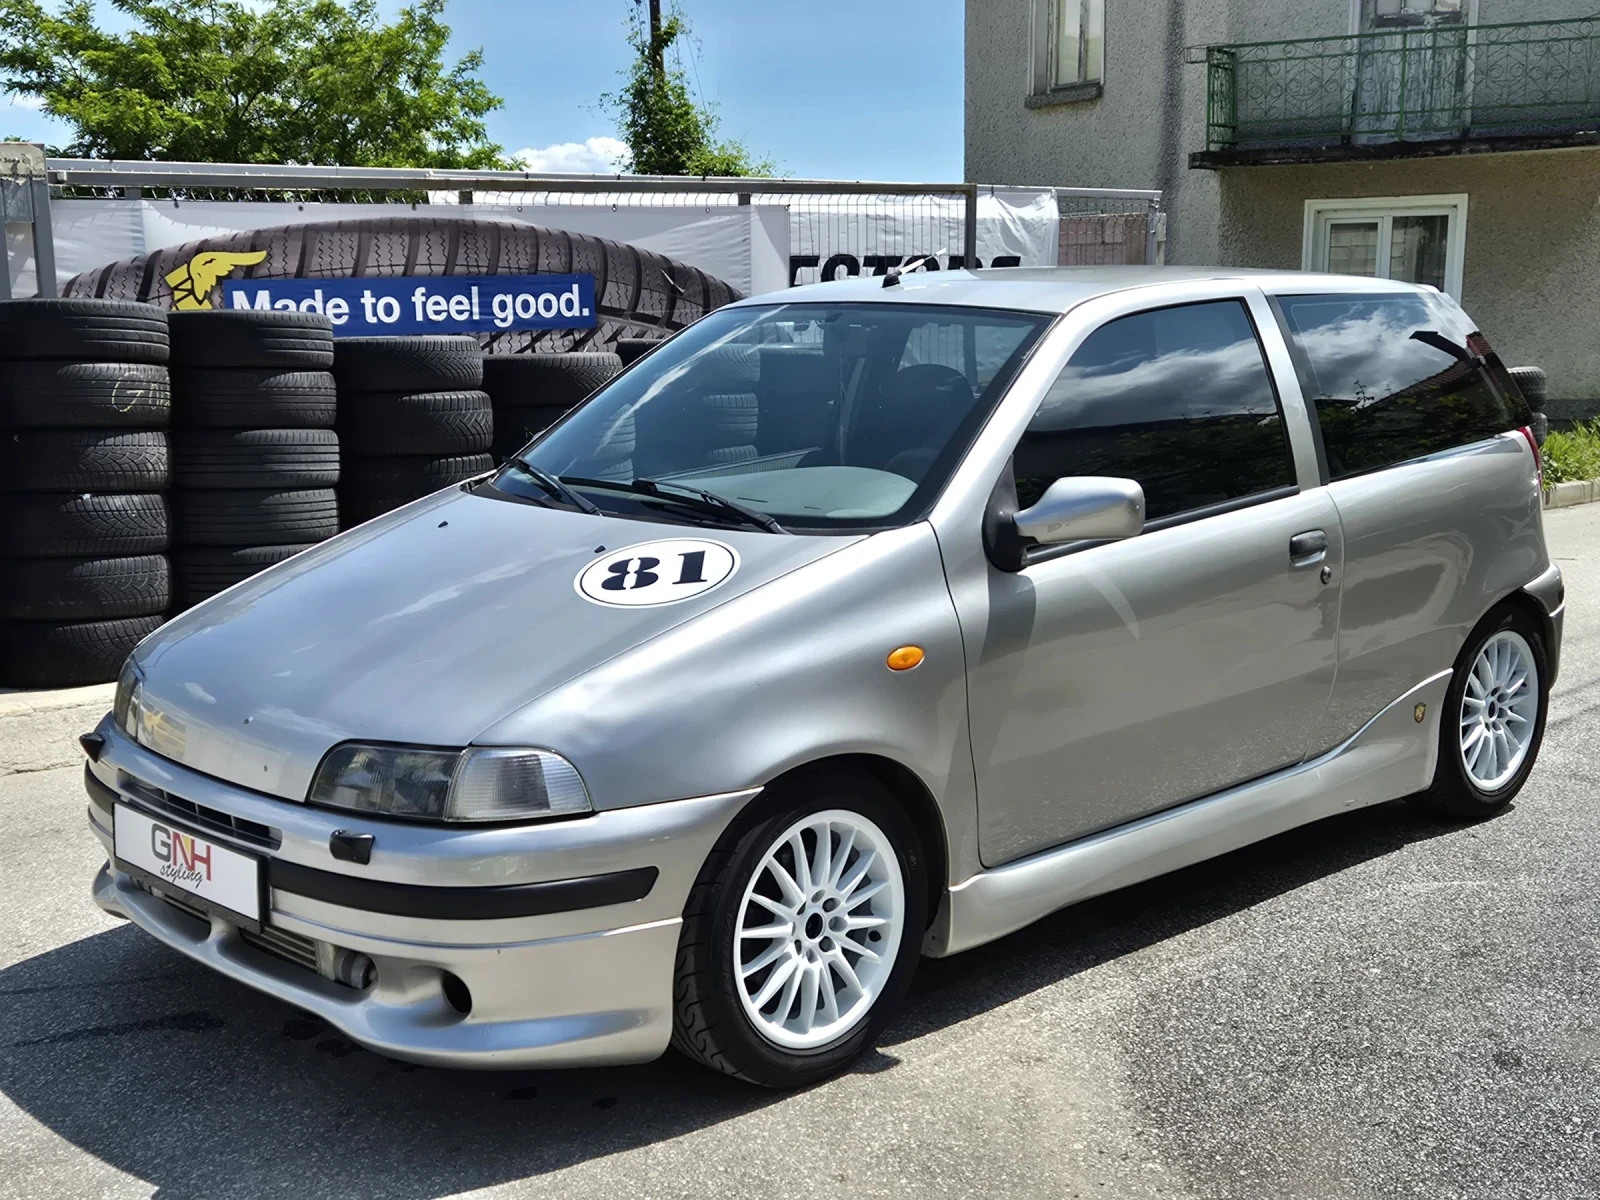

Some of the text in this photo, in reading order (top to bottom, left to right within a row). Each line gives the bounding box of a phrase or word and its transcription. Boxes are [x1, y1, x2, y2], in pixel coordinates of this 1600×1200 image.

[232, 284, 590, 328] Made to feel good.
[601, 550, 708, 590] 81
[151, 823, 211, 882] GNH
[160, 862, 203, 889] styling
